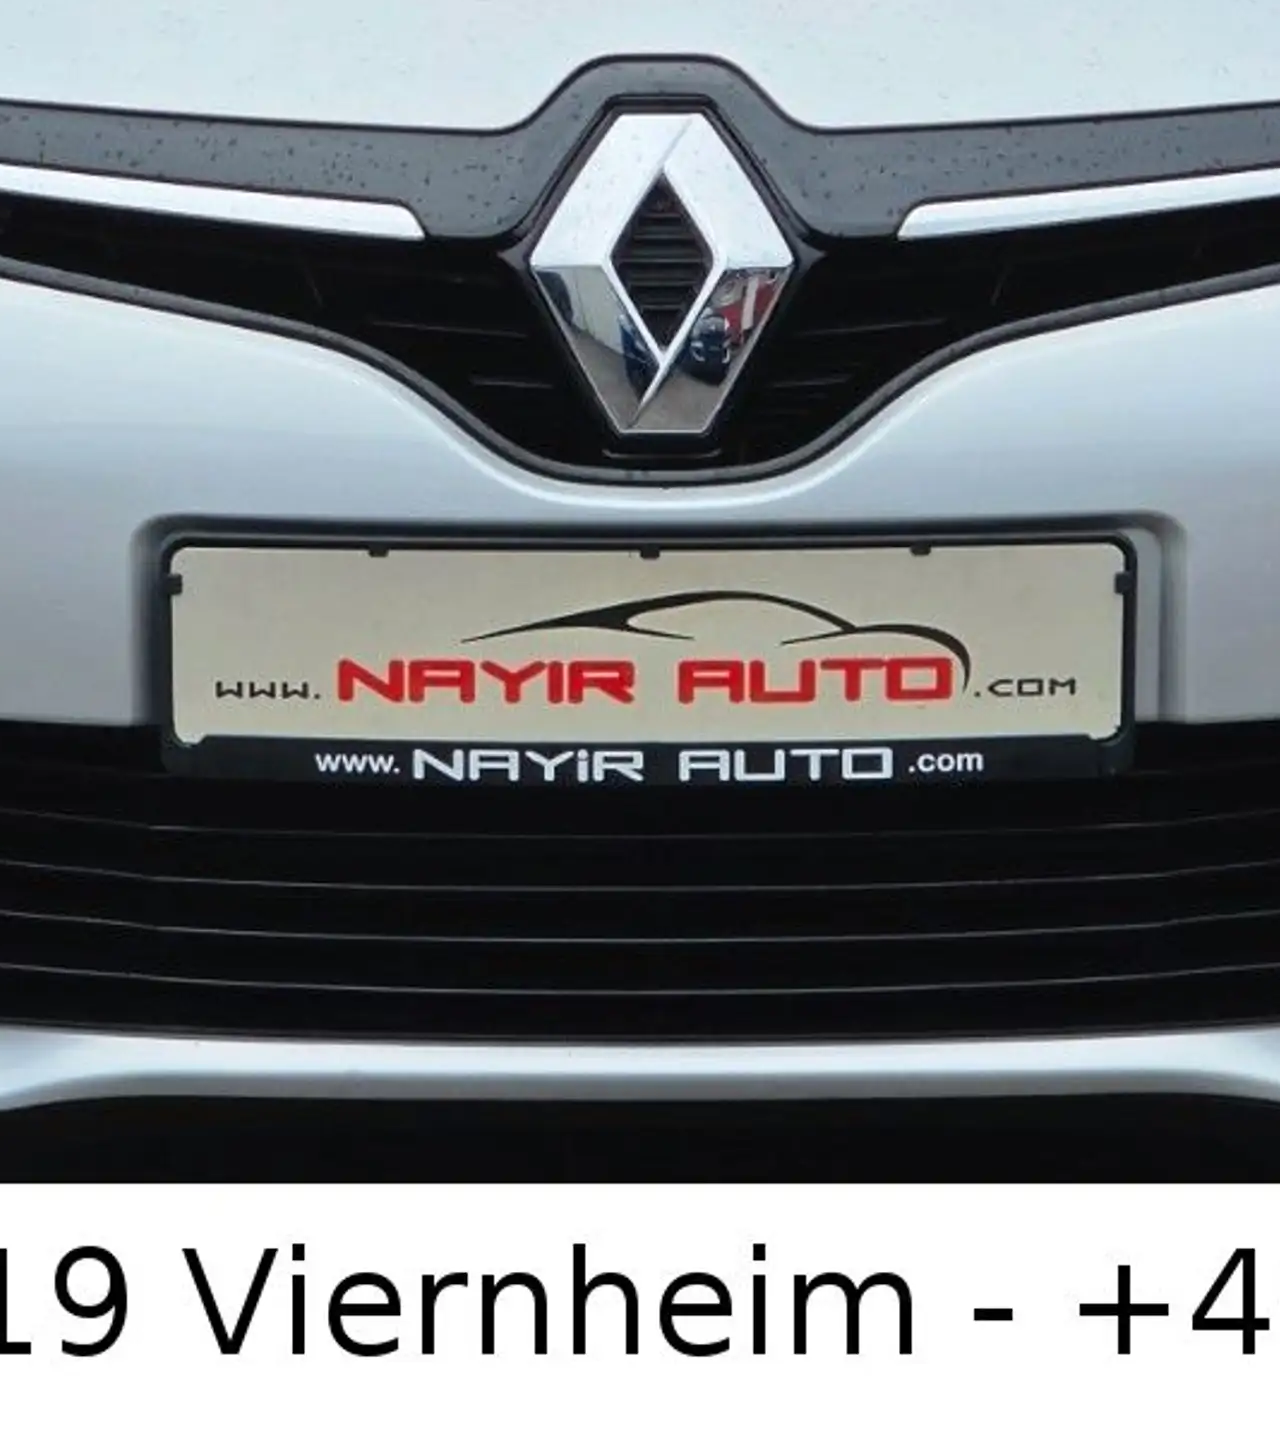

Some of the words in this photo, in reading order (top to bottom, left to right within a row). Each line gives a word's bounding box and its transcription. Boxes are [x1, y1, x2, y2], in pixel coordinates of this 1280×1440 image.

[676, 656, 954, 704] AUTO
[314, 752, 401, 774] www.
[677, 746, 894, 782] AUTO
[907, 751, 985, 773] .com
